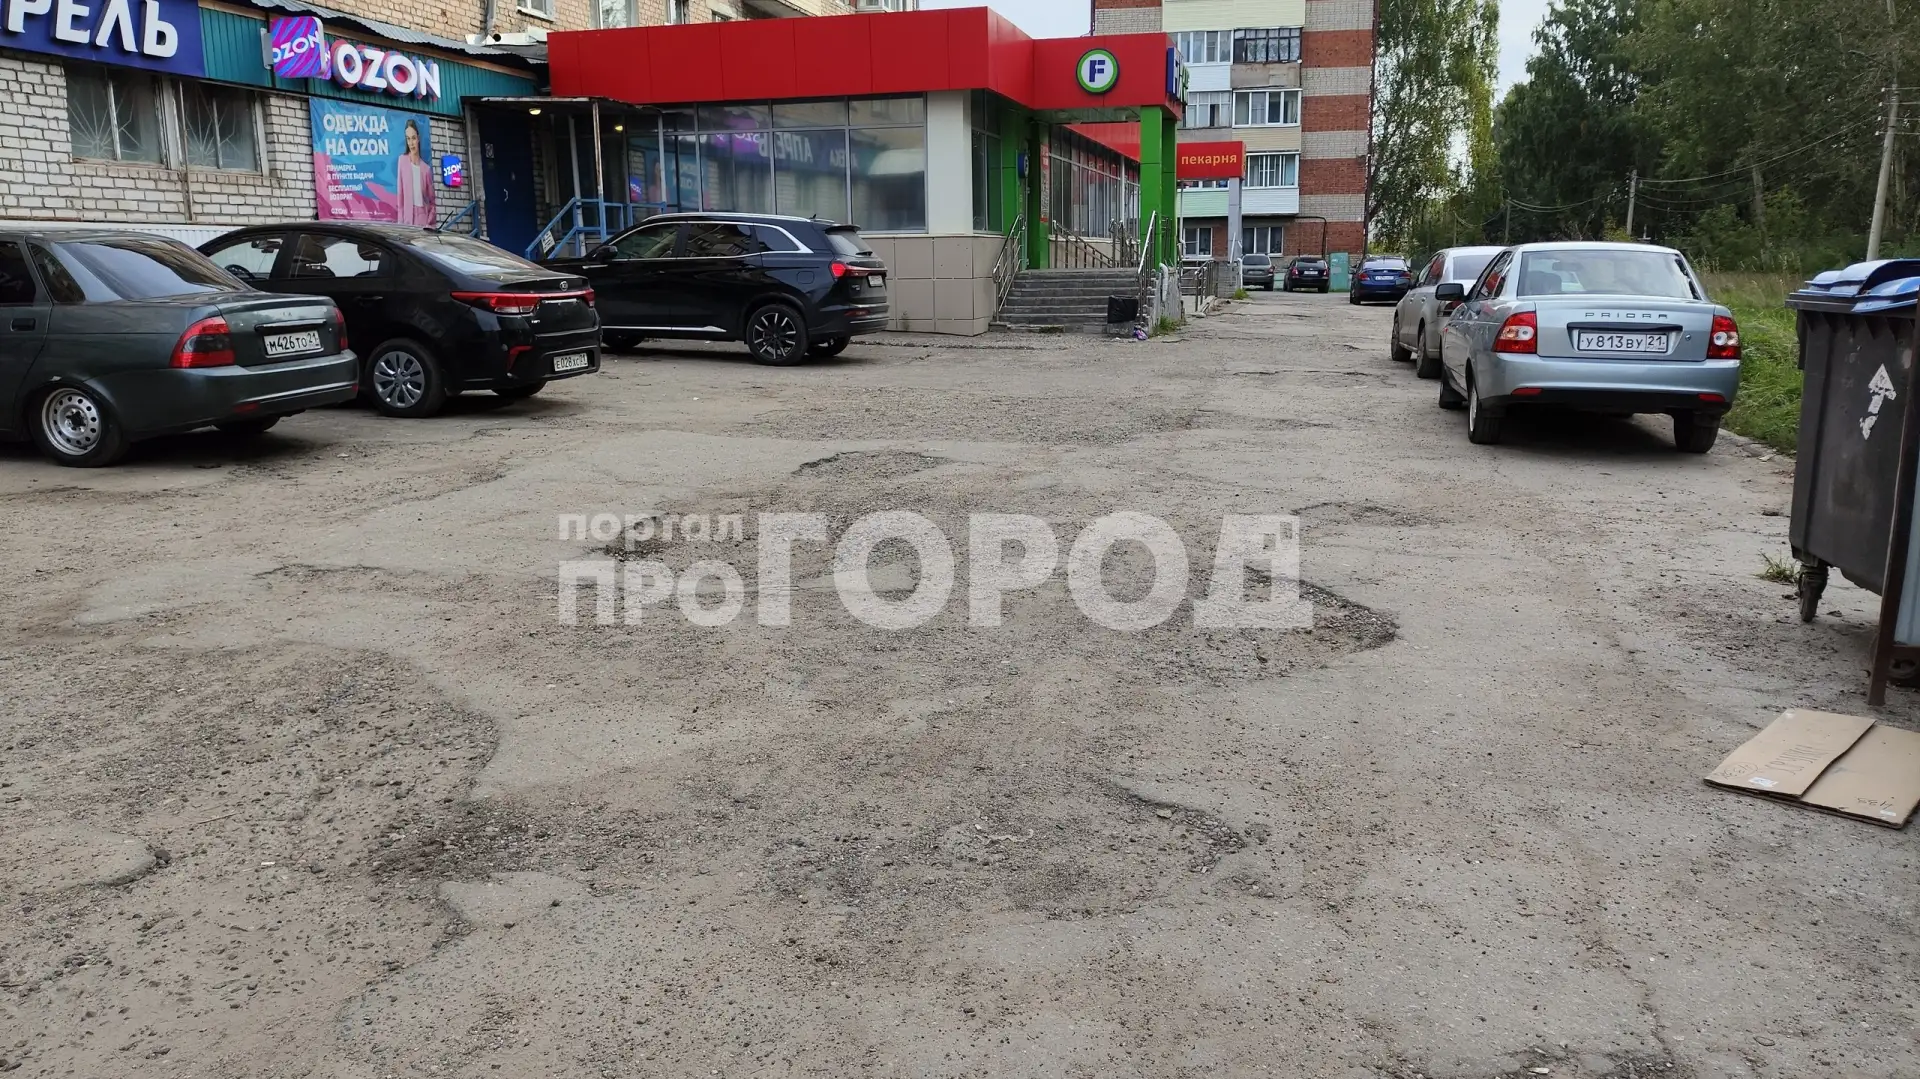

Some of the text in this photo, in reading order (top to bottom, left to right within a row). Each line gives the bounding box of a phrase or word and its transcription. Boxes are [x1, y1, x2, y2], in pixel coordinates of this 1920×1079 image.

[273, 31, 321, 63] OZON
[334, 42, 441, 99] OZON
[1088, 59, 1106, 83] F
[323, 114, 389, 135] ОДЕЖДА
[325, 138, 389, 155] НА OZON
[1181, 153, 1237, 167] пекарня
[1586, 335, 1661, 349] У813ВУ 21
